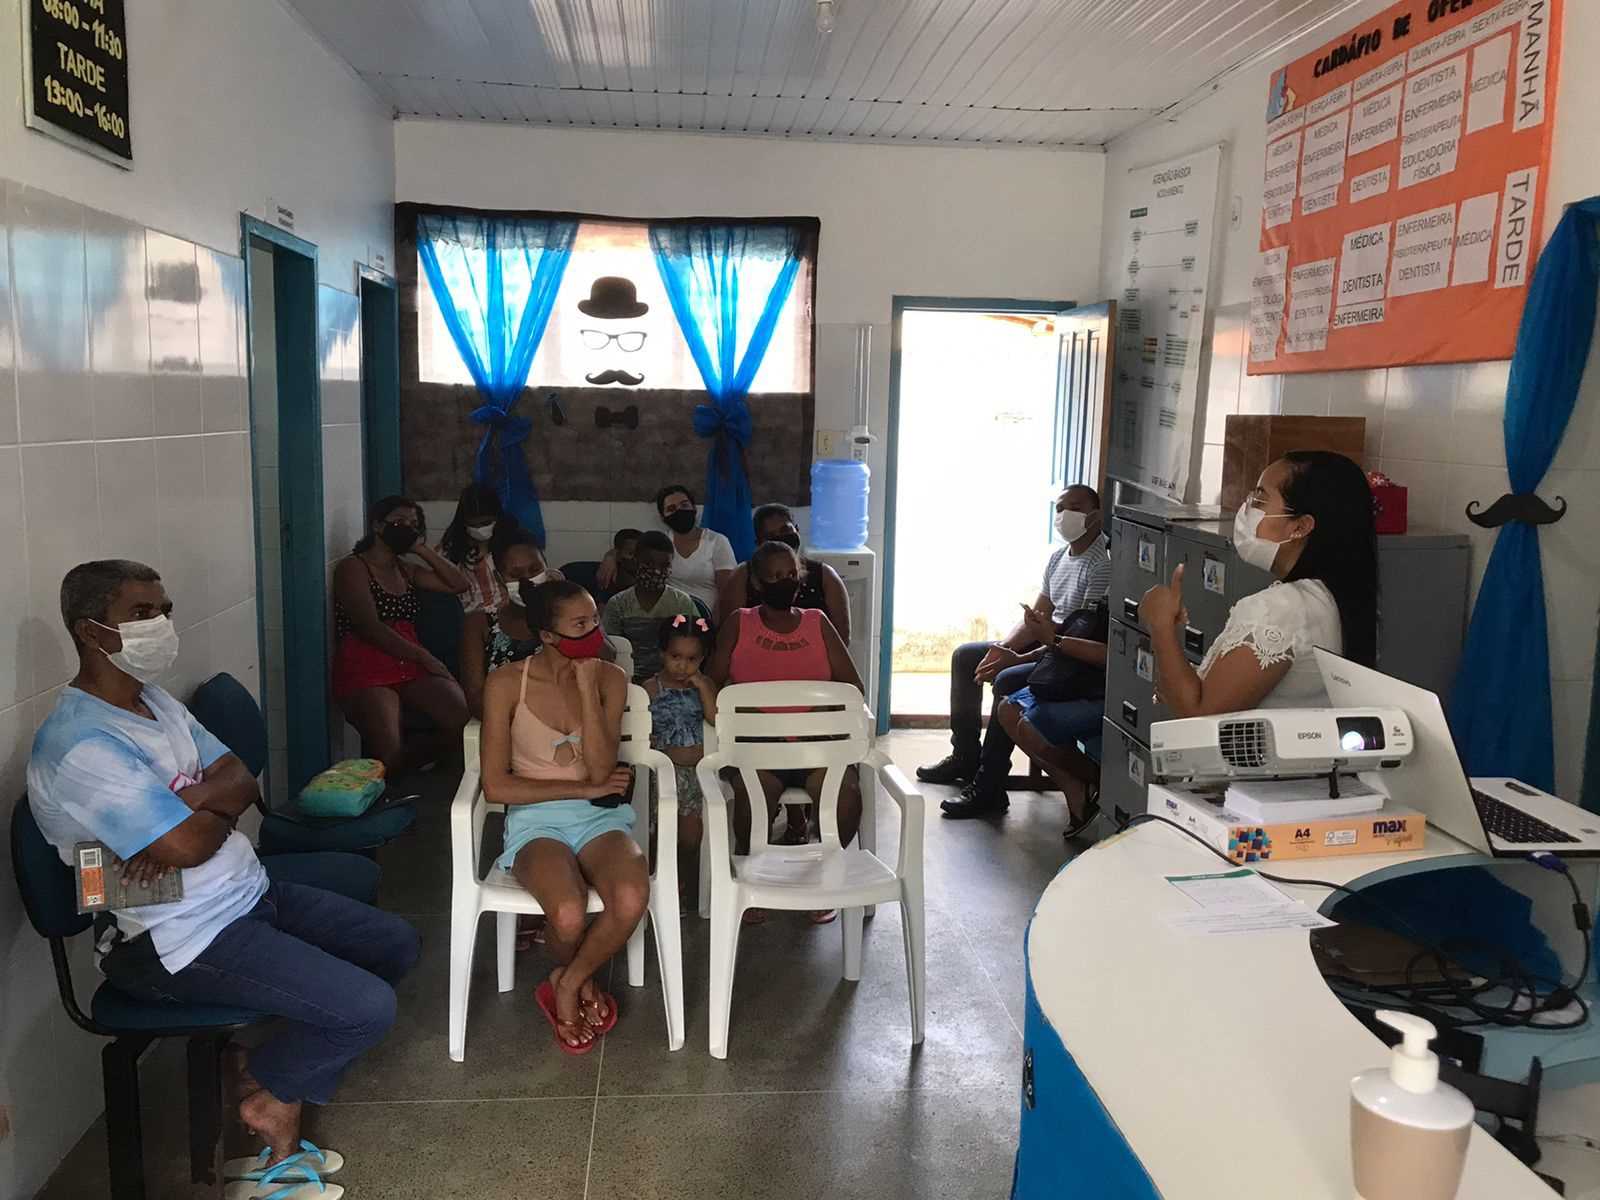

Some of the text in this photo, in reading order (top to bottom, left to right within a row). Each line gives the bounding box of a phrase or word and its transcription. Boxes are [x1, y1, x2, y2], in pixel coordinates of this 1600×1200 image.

[1392, 13, 1412, 41] DE
[57, 42, 106, 93] TARDE
[1519, 0, 1545, 121] MANHÃ
[1412, 65, 1457, 94] DENTISTA
[1404, 89, 1463, 123] ENFERMEIRA
[1402, 138, 1457, 169] EDUCADORA
[1352, 170, 1388, 193] DENTISTA
[1398, 211, 1453, 236] ENFERMEIRA
[1502, 173, 1530, 283] TARDE
[1350, 231, 1384, 250] MÉDICA
[1456, 229, 1493, 247] MÉDICA
[1343, 272, 1384, 294] DENTISTA
[1398, 262, 1441, 281] DENTISTA
[1333, 307, 1385, 327] ENFERMEIRA
[1297, 731, 1322, 740] EPSON
[1294, 827, 1311, 839] A4
[1372, 820, 1407, 834] max
